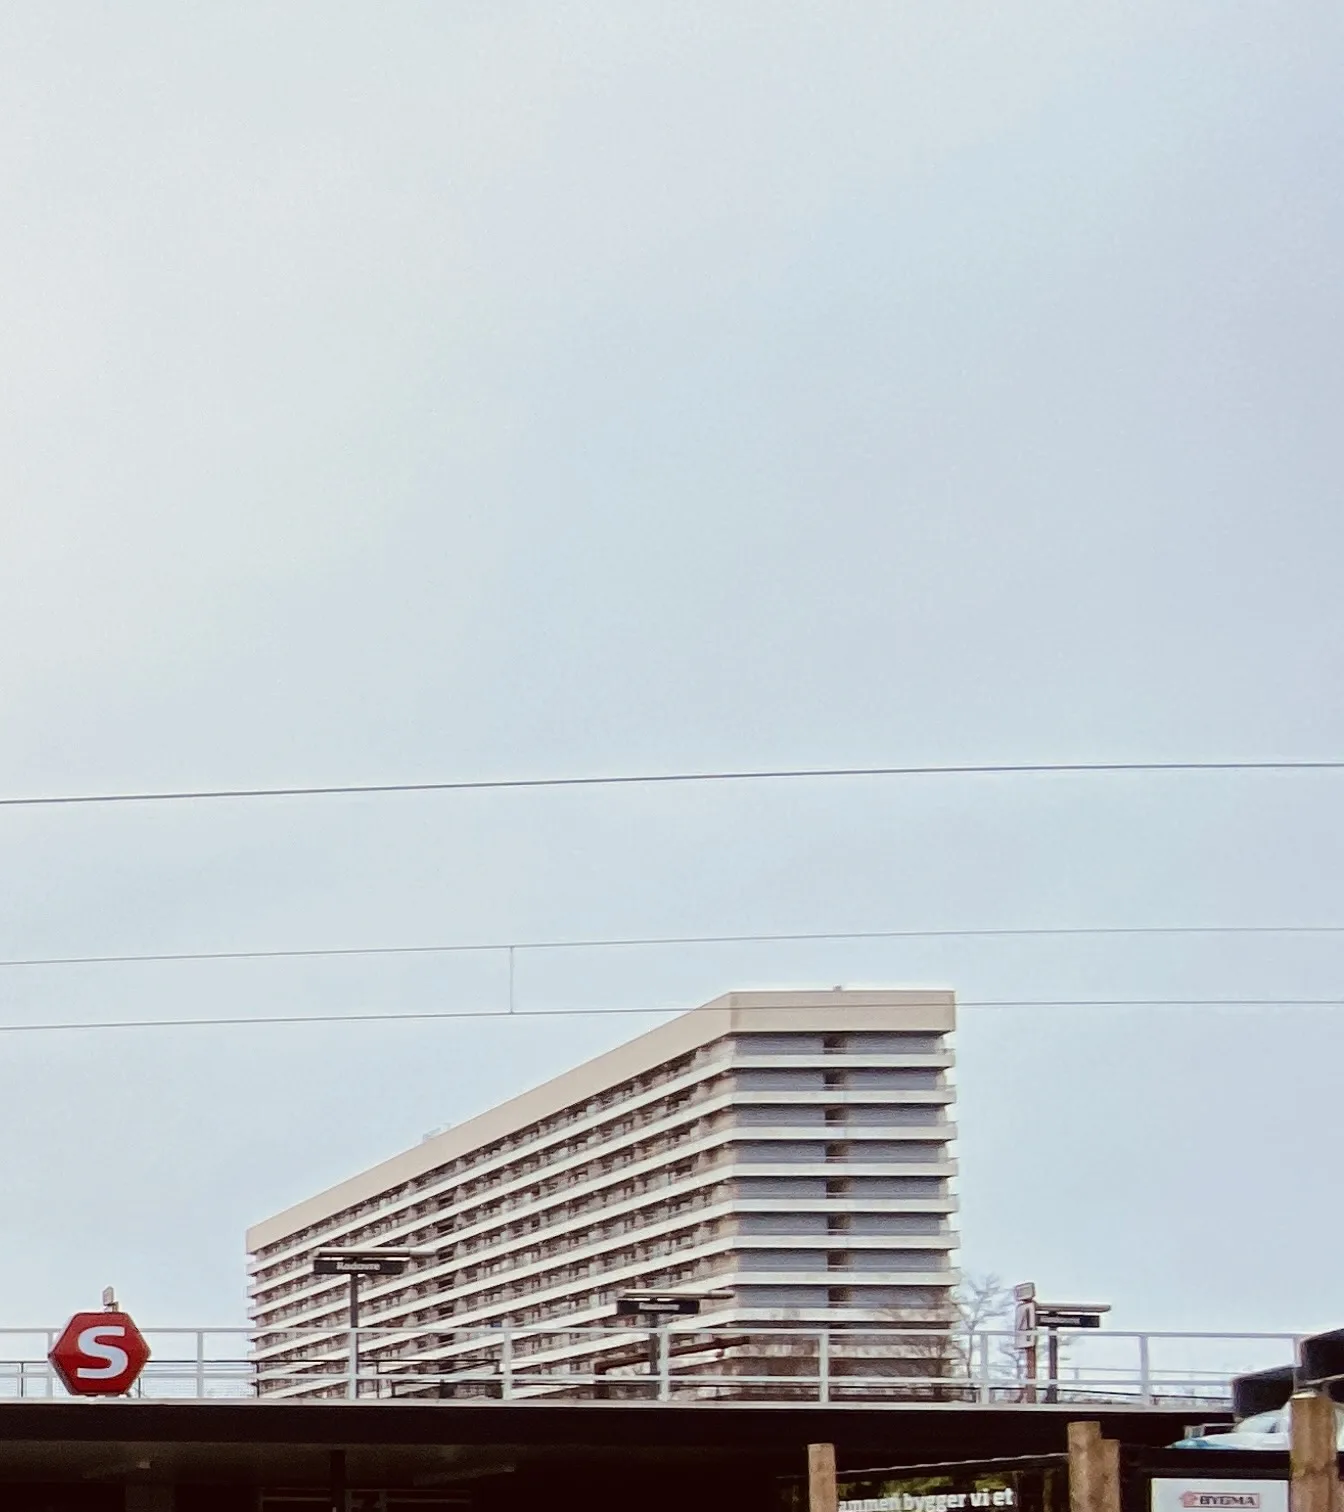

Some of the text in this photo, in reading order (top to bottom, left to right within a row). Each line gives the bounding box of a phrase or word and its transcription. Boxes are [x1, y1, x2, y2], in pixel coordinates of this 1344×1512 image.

[77, 1325, 129, 1379] S
[838, 1487, 1013, 1512] ammen bygger vi et
